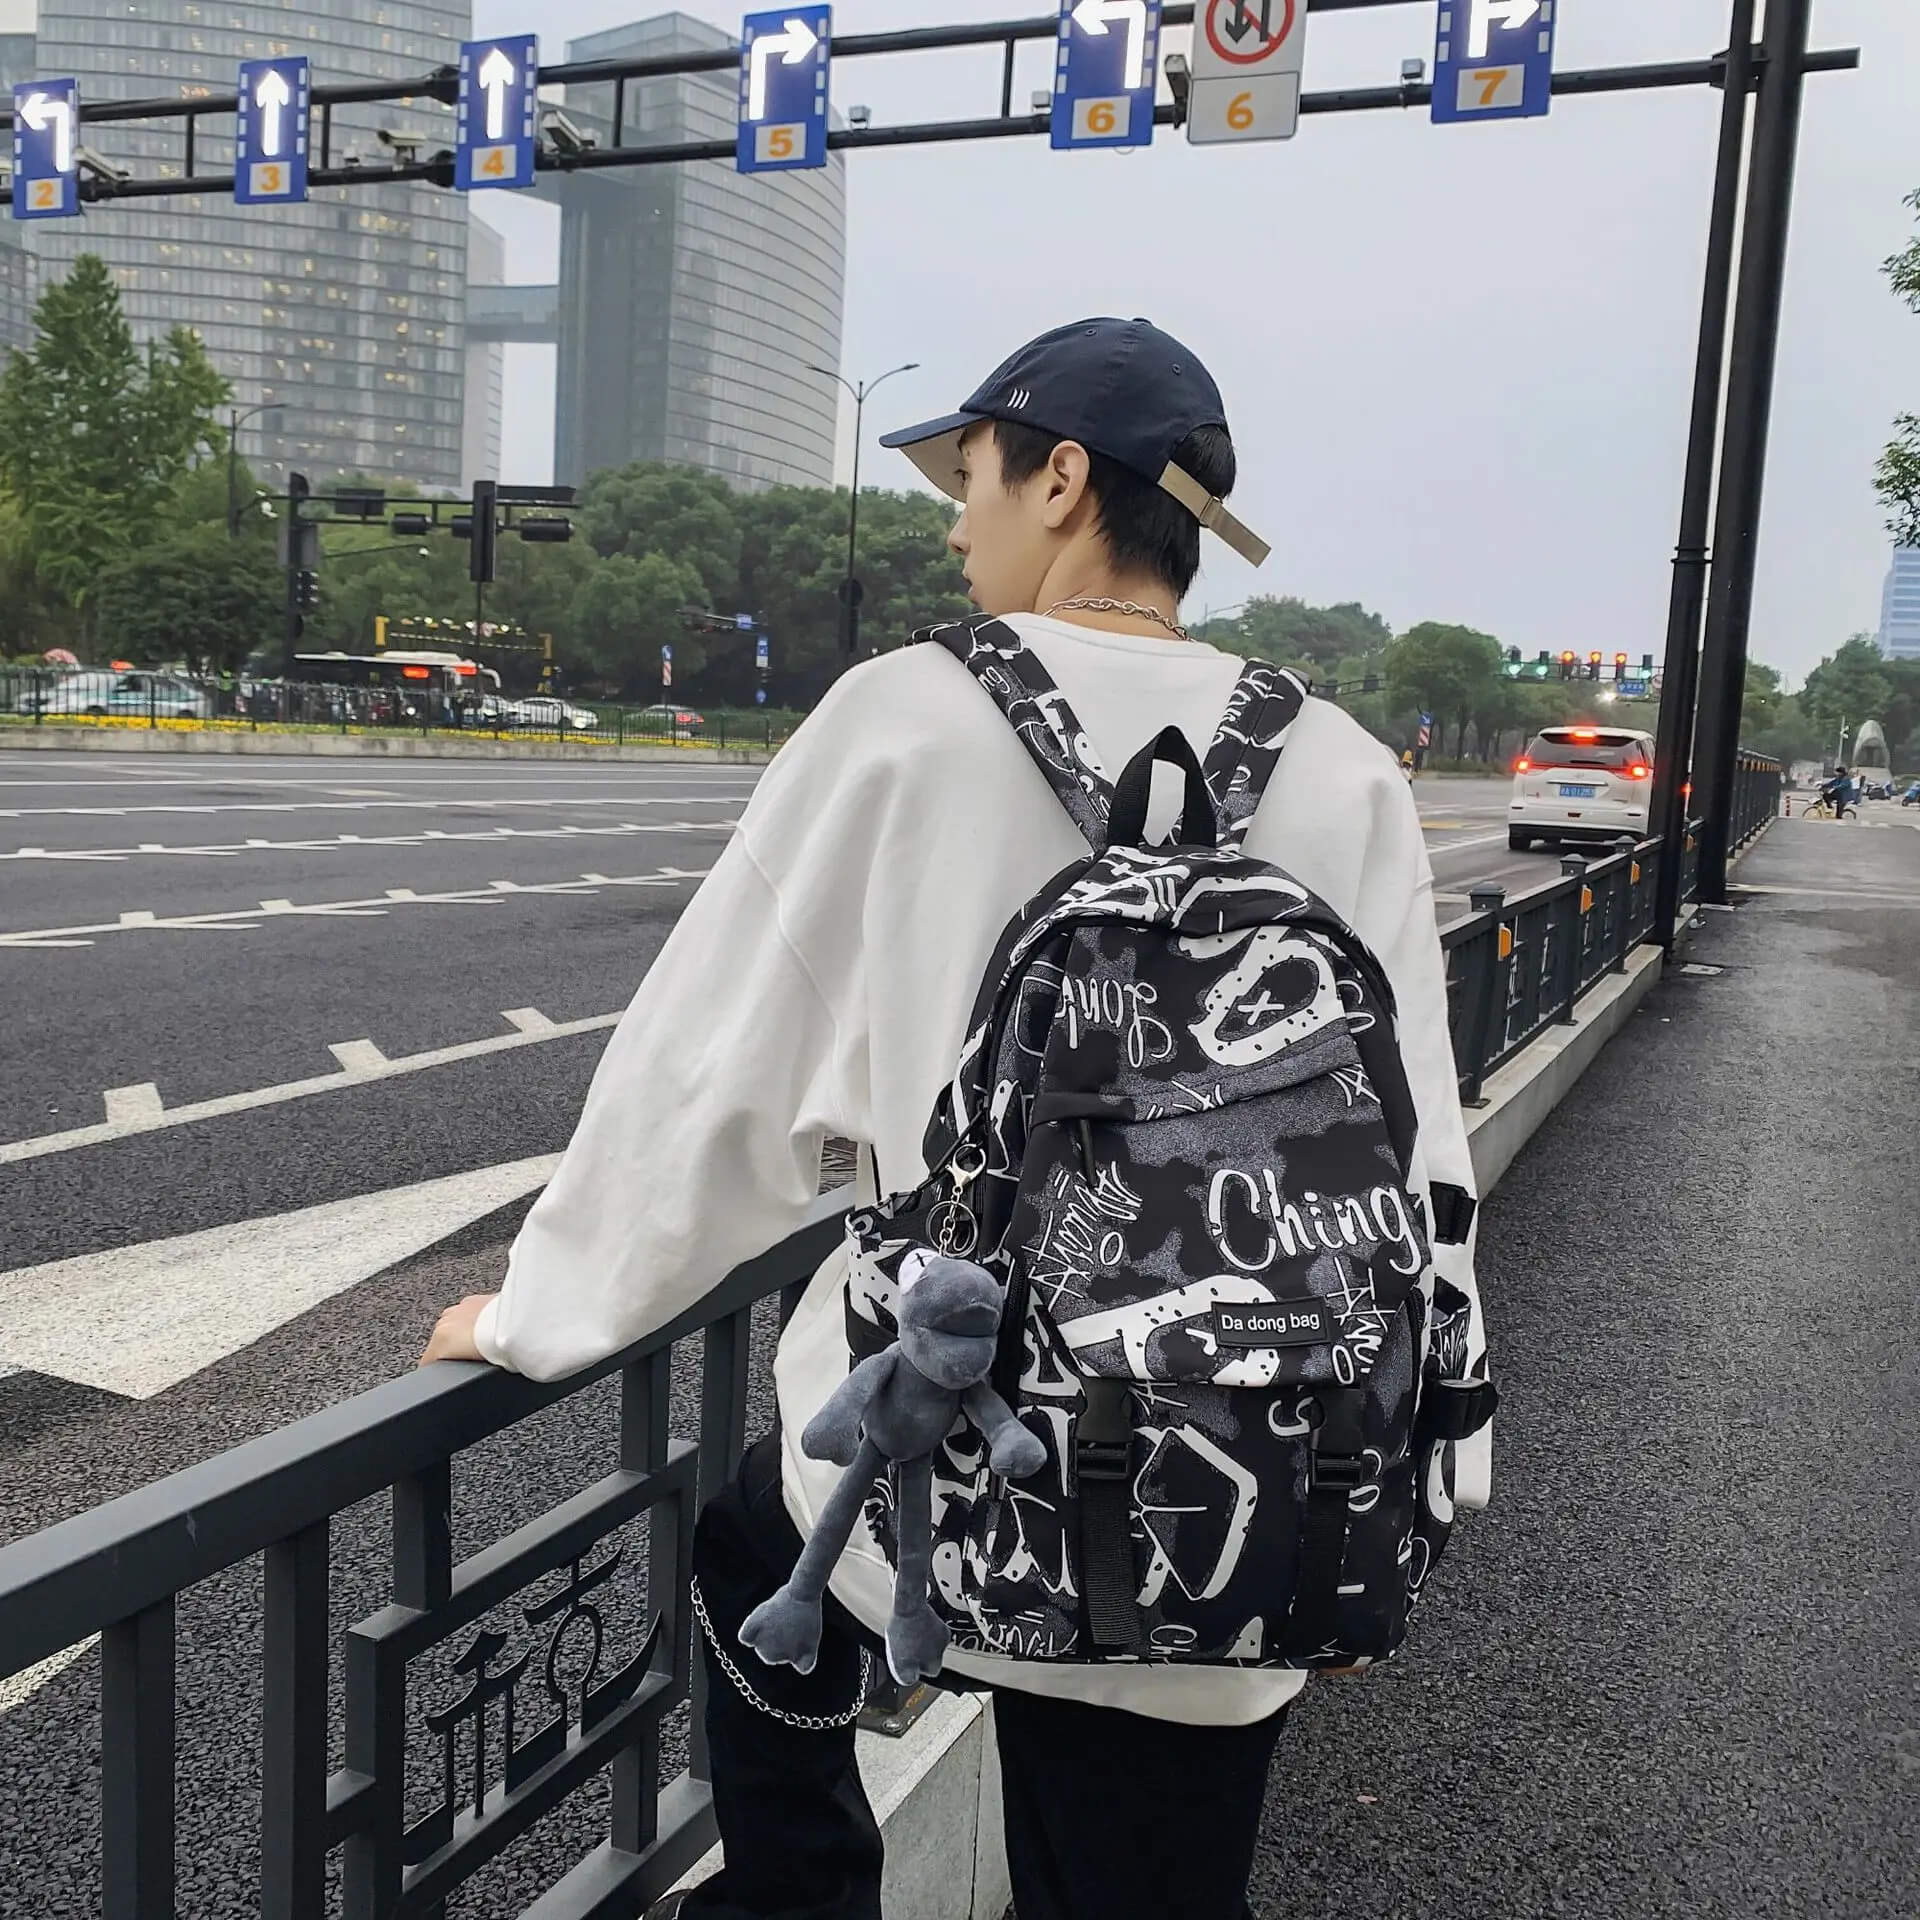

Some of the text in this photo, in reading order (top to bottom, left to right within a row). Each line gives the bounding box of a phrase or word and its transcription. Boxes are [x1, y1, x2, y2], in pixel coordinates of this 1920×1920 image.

[1473, 69, 1508, 105] 7
[1087, 101, 1116, 134] 6
[1226, 92, 1254, 131] 6
[768, 127, 793, 158] 5
[482, 149, 505, 176] 4
[35, 181, 54, 207] 2
[260, 165, 281, 192] 3
[1208, 1168, 1422, 1275] Ching
[1221, 1312, 1320, 1333] Da dong bag
